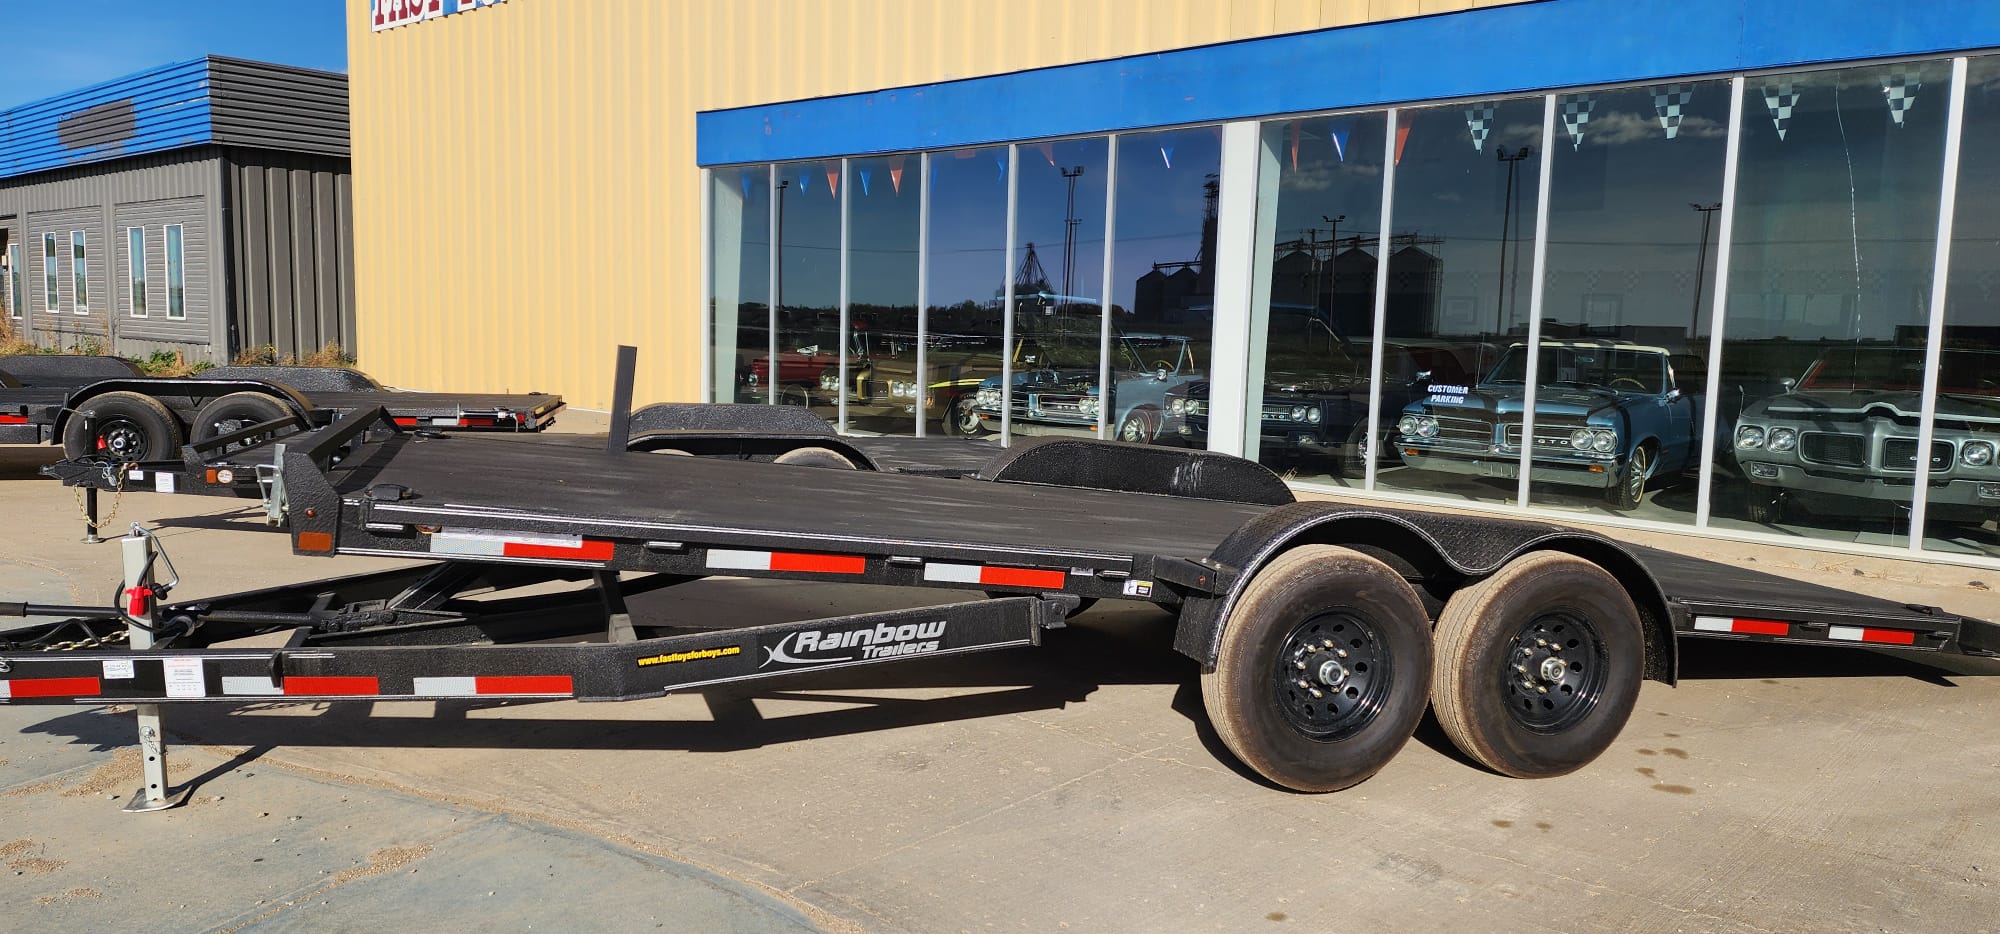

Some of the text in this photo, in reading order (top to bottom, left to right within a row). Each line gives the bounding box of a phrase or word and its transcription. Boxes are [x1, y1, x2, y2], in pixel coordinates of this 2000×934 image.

[1427, 384, 1469, 395] CUSTOMER
[1431, 394, 1464, 404] PARKING
[794, 620, 947, 654] Rainbow
[638, 646, 740, 666] www.fasttoysforboys.com
[862, 640, 940, 659] Trailers
